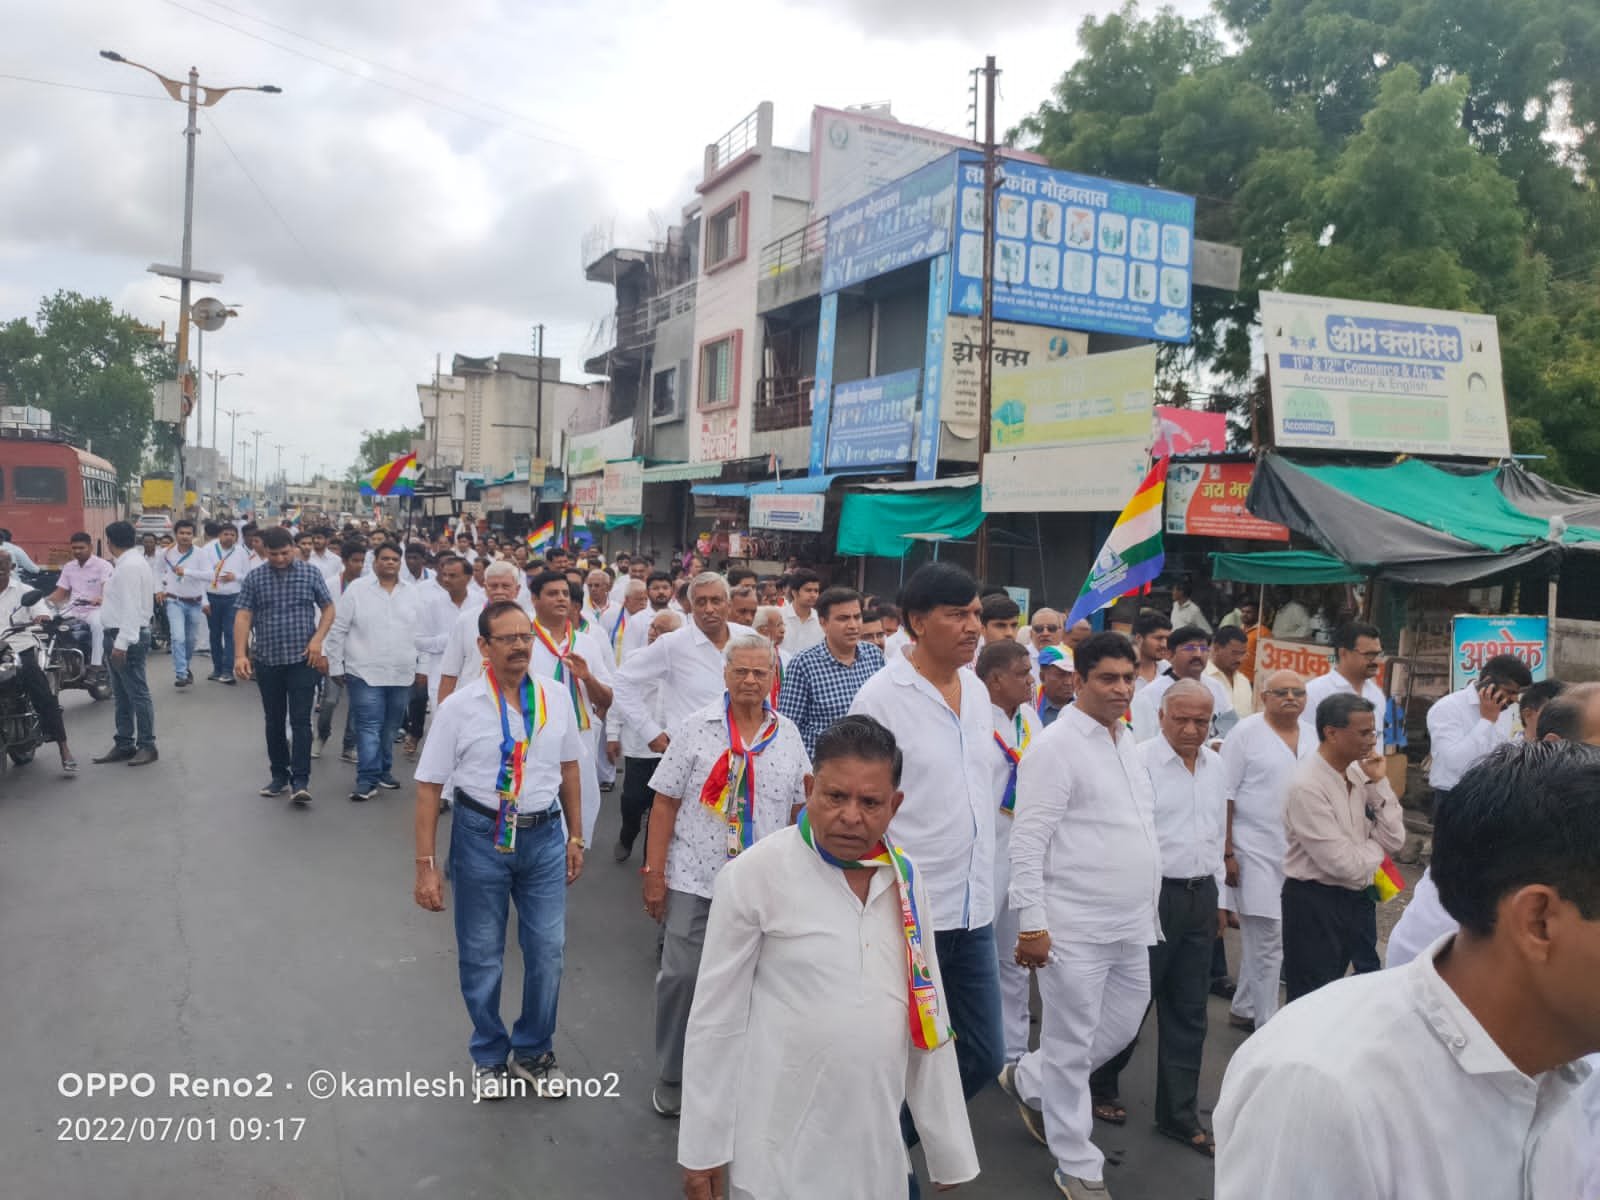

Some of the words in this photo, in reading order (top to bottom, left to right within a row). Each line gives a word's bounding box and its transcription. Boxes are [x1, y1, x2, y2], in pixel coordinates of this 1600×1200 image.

[1329, 317, 1377, 353] ओम
[1378, 325, 1460, 362] क्लासेस
[1292, 355, 1310, 370] 11th
[1311, 358, 1322, 370] &
[1323, 358, 1342, 372] 12th
[1343, 360, 1400, 378] Commerce
[1401, 365, 1411, 378] &
[1412, 366, 1434, 381] Arts
[1303, 373, 1376, 393] Accountancy
[1377, 376, 1388, 389] &
[1389, 377, 1429, 393] English
[1284, 420, 1335, 435] Accountancy
[1200, 481, 1225, 499] जय
[1261, 642, 1331, 677] अशोक
